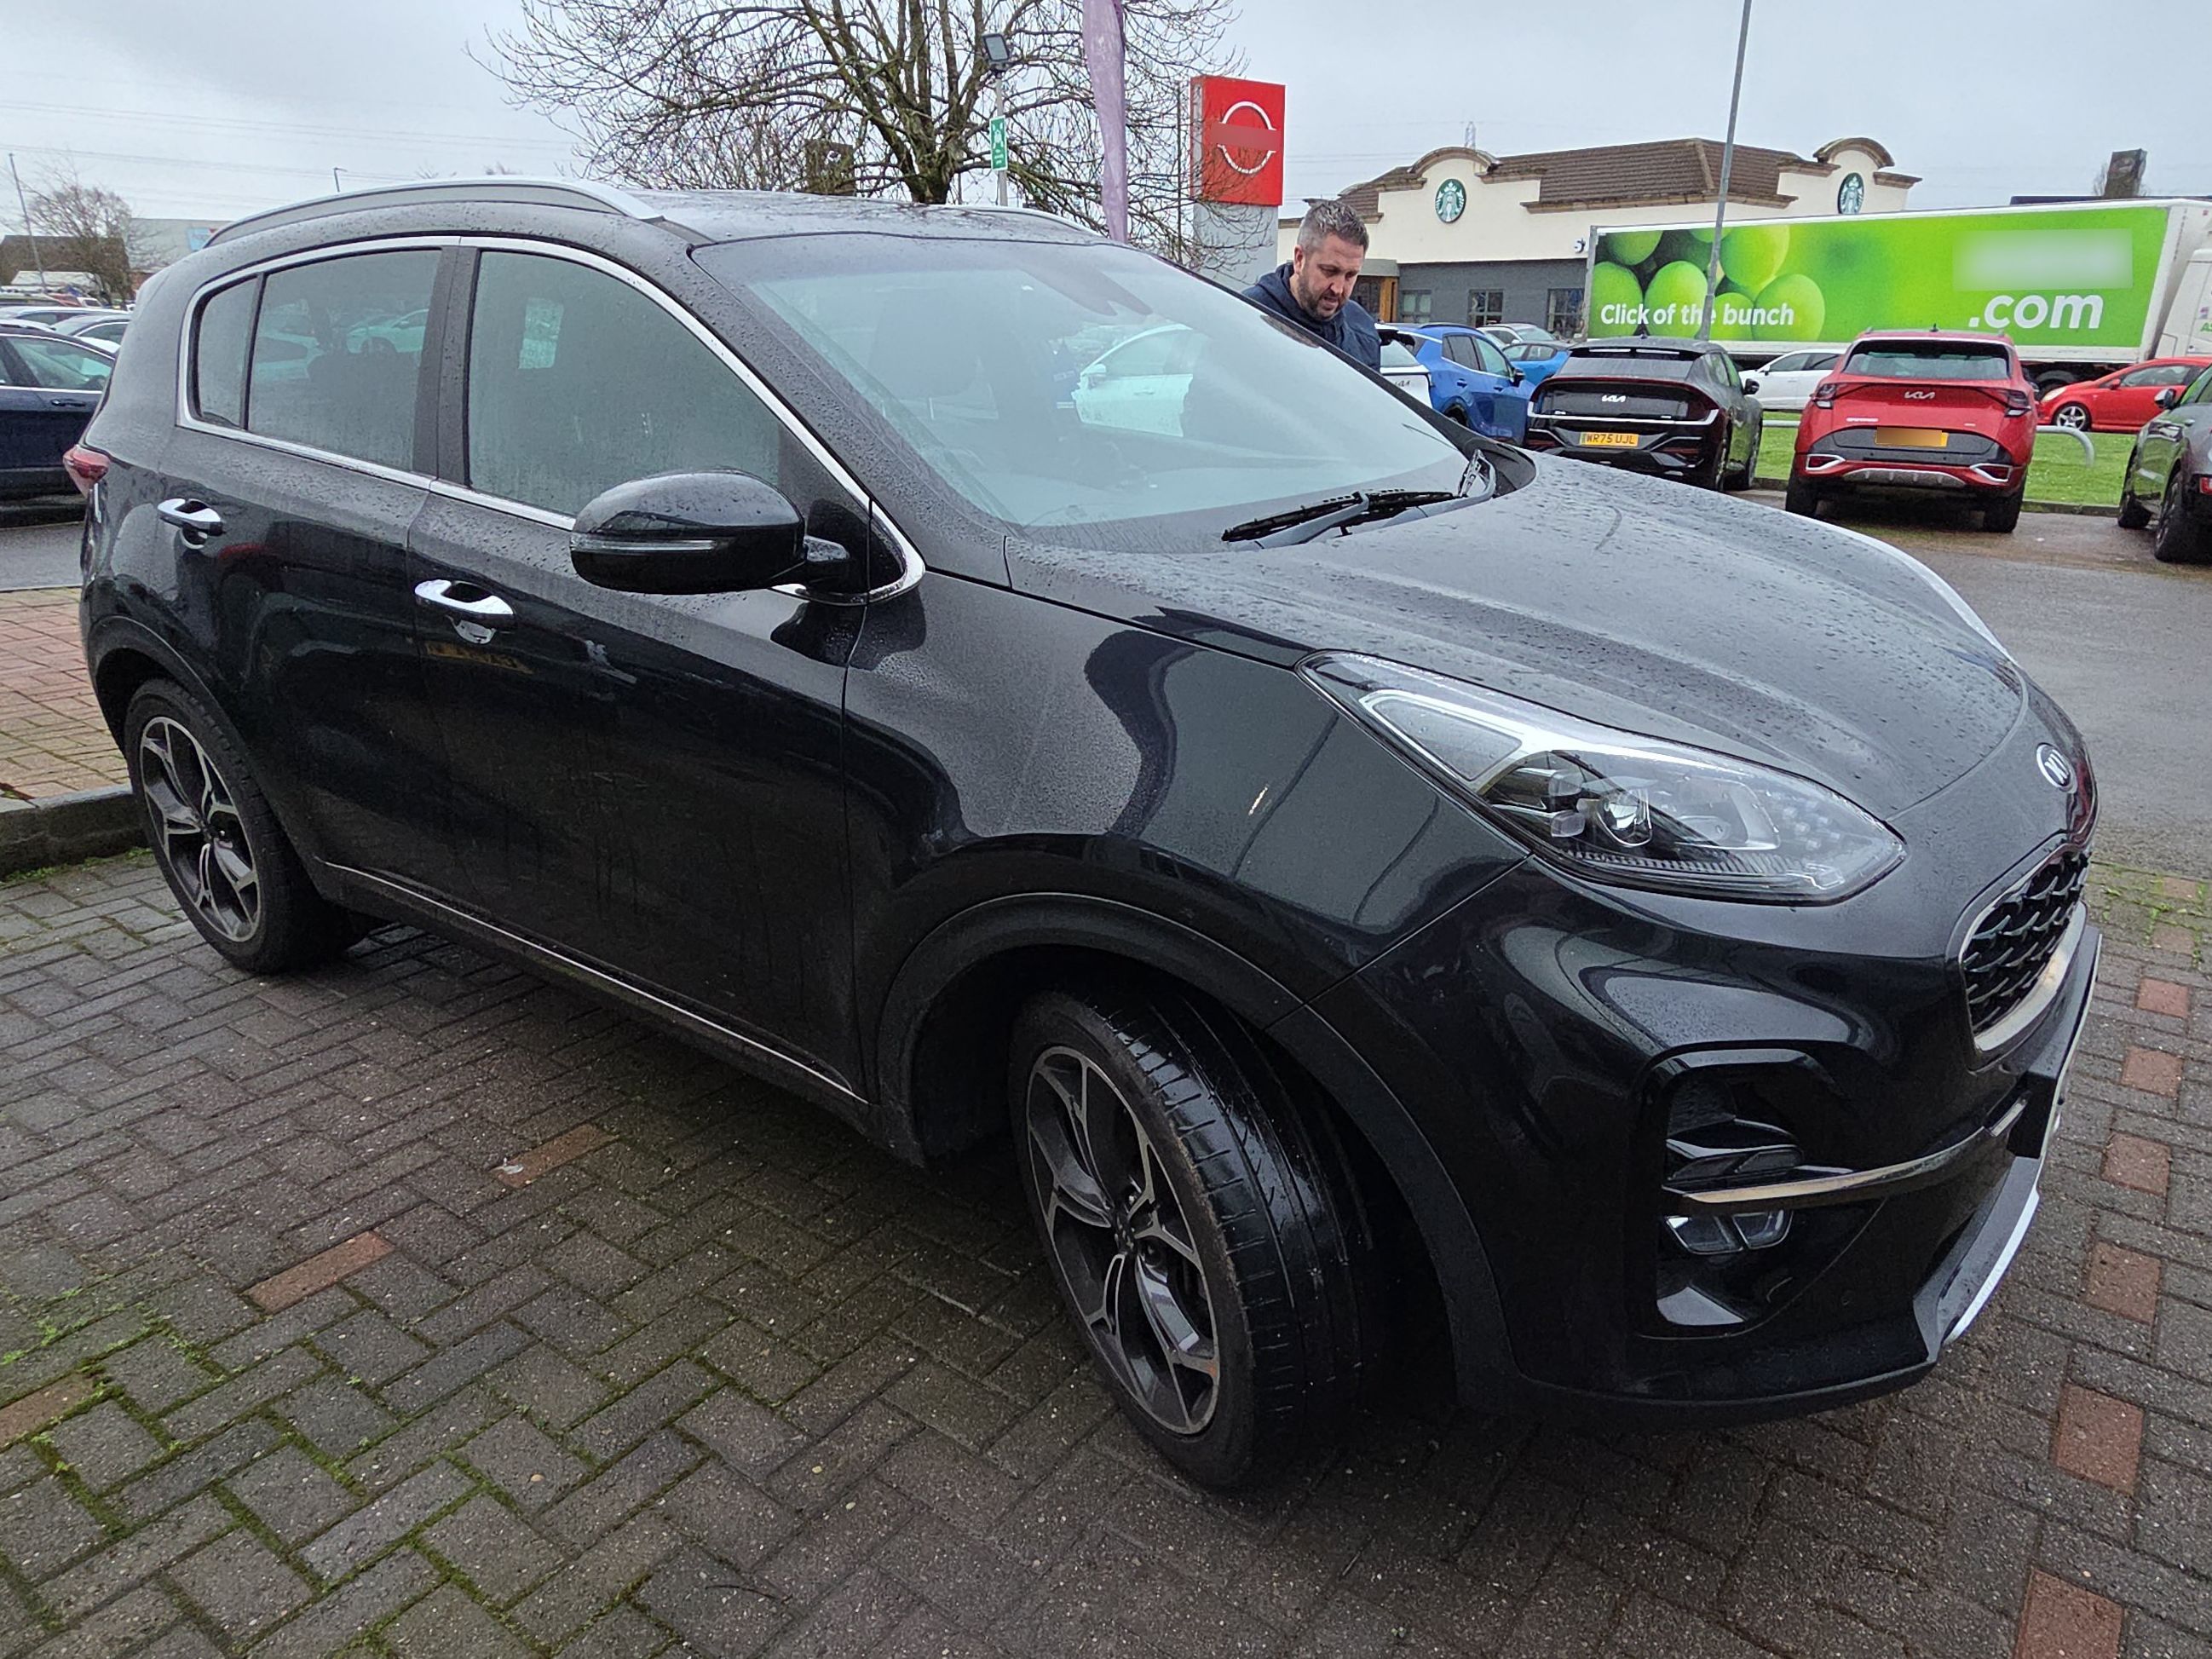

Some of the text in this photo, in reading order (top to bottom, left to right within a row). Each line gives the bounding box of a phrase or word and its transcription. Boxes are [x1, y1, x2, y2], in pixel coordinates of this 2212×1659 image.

[1601, 303, 1649, 325] Click
[1653, 303, 1676, 325] of
[1723, 303, 1794, 325] bunch
[1968, 295, 2104, 329] .com
[1587, 434, 1635, 445] WR75 UJL
